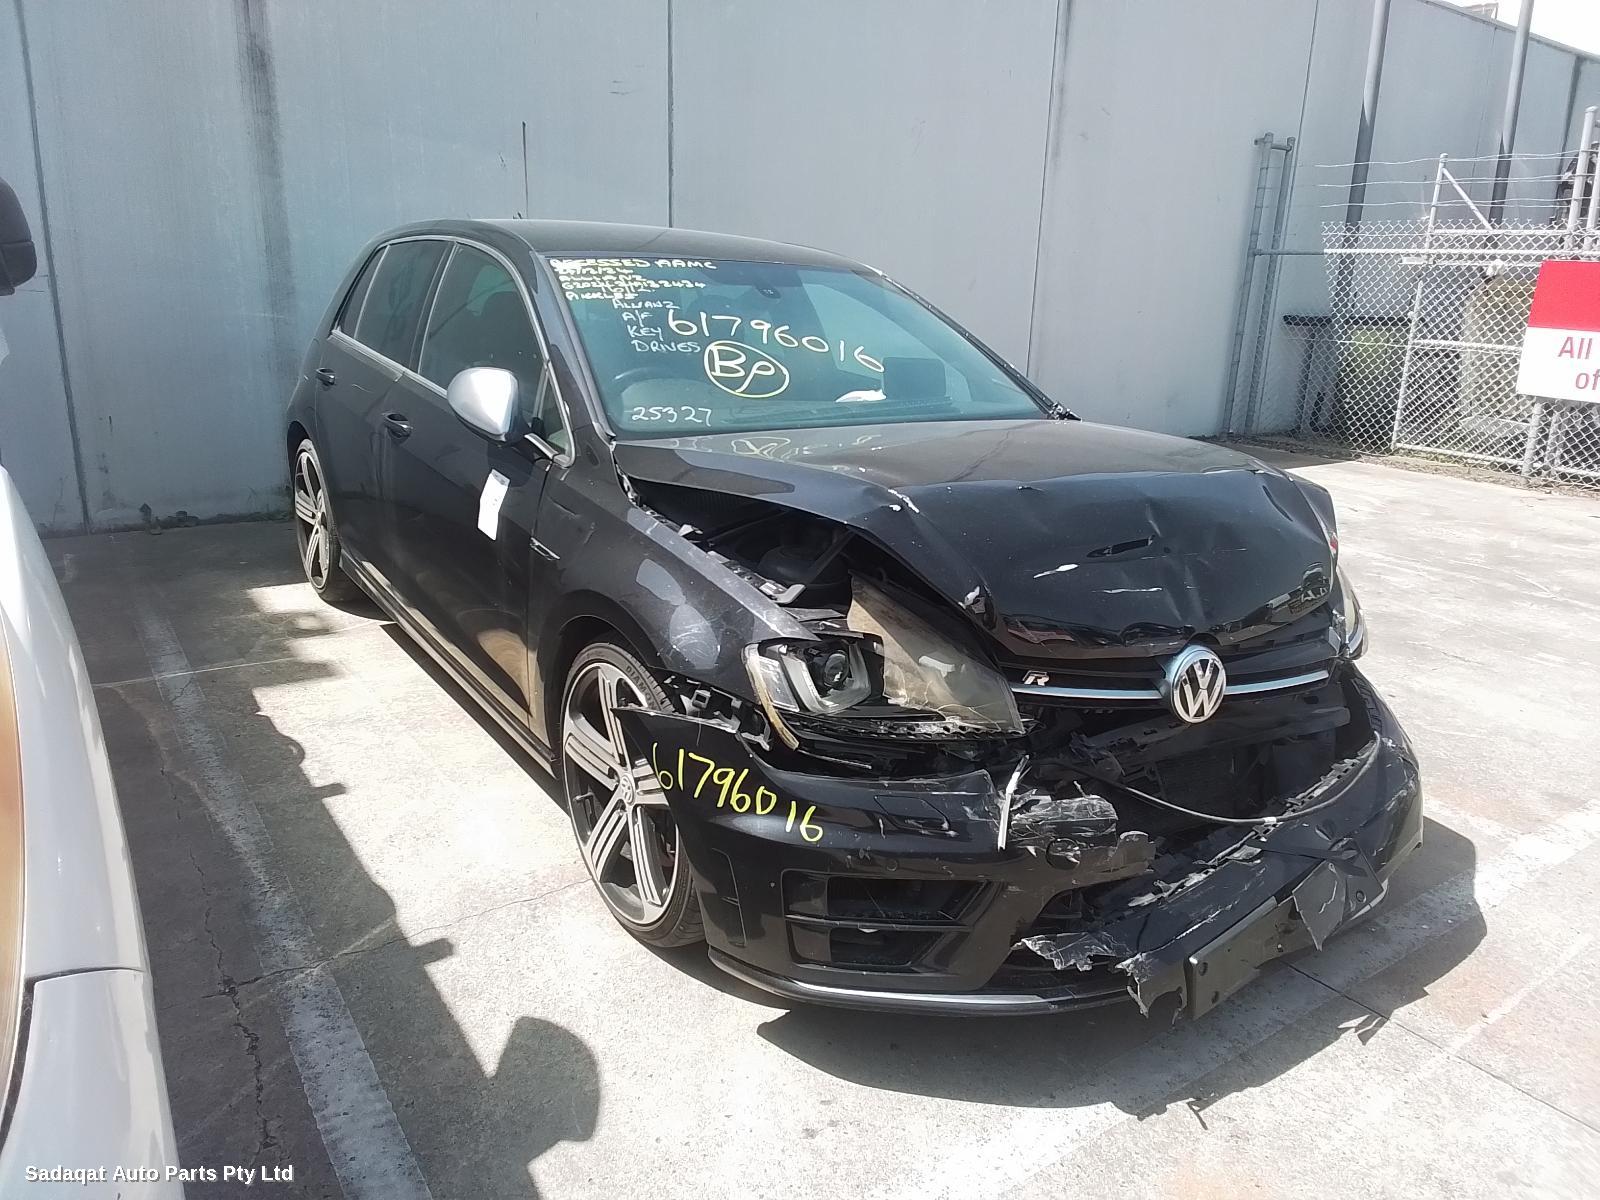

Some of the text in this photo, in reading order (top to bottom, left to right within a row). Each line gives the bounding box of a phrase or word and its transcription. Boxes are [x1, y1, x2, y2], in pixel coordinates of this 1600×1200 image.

[622, 309, 654, 327] A/F
[627, 325, 664, 341] KEY
[668, 308, 884, 373] 61796016
[631, 339, 701, 353] DRIVES
[1557, 336, 1593, 360] All
[631, 406, 712, 427] 25327
[1022, 670, 1050, 686] R
[1174, 655, 1225, 722] VW
[652, 742, 824, 842] 61796016
